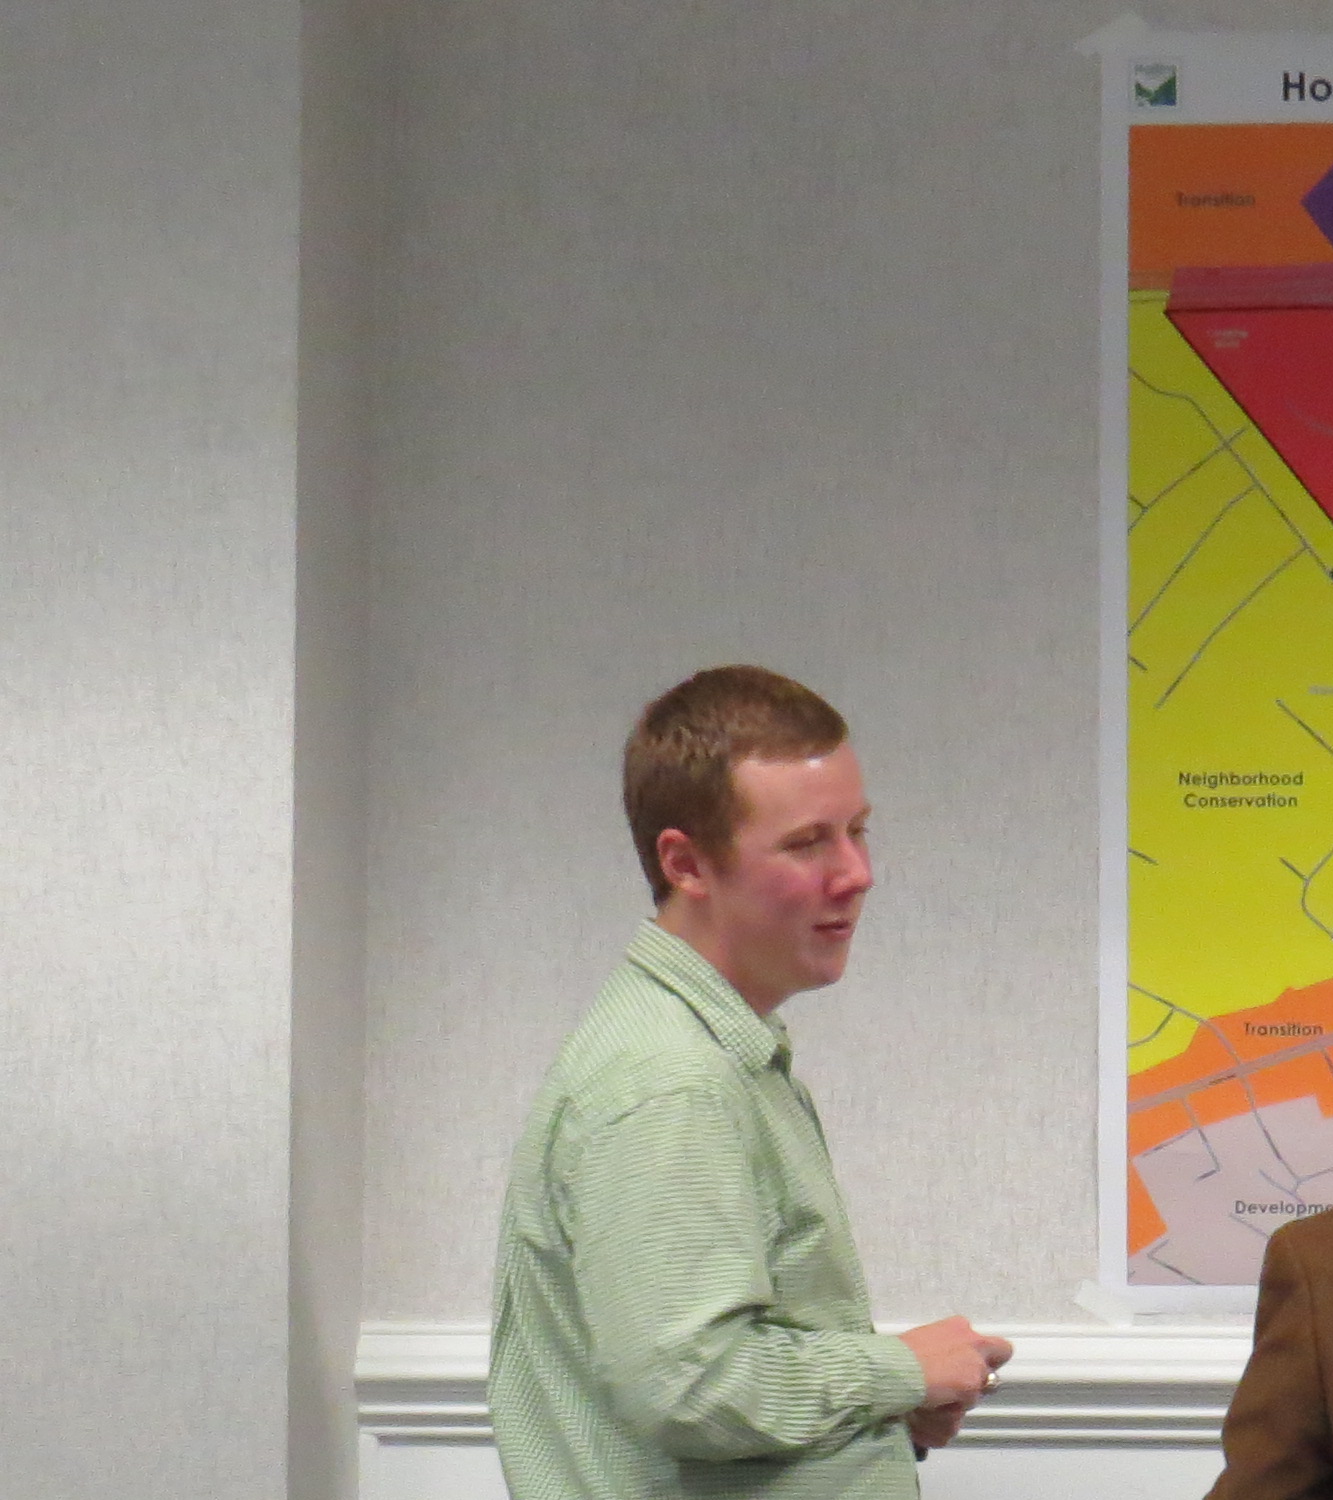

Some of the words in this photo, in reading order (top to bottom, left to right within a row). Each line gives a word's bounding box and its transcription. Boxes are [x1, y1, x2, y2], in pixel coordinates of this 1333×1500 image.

[1178, 771, 1304, 788] Neighborhood
[1183, 792, 1298, 808] Conservation
[1243, 1021, 1324, 1037] Transition
